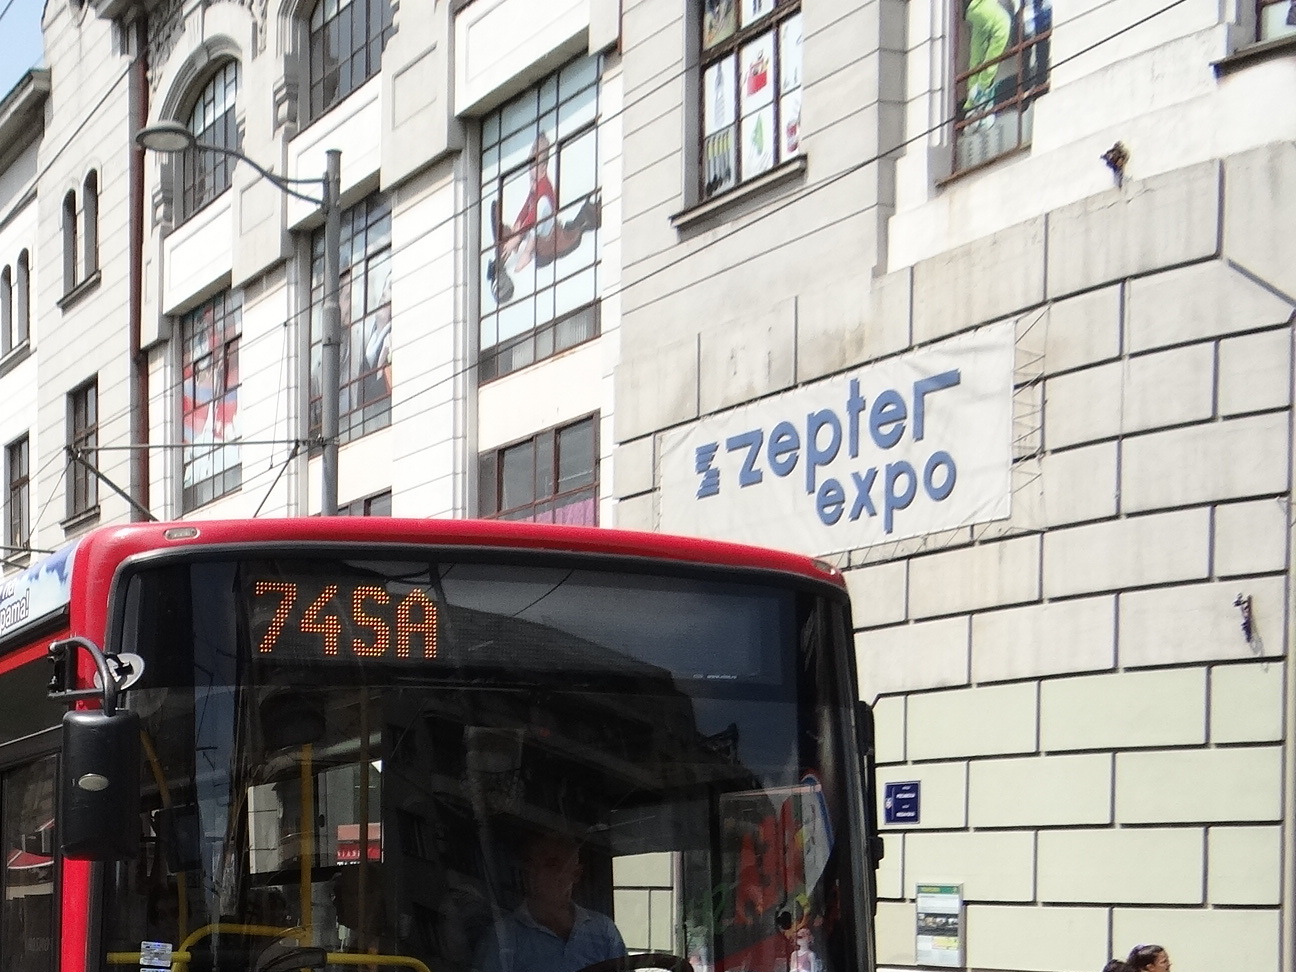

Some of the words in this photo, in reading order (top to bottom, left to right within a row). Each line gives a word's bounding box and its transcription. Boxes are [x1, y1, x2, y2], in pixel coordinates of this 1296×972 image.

[725, 368, 961, 495] zepter
[816, 450, 957, 535] expo
[255, 581, 437, 657] 74SA
